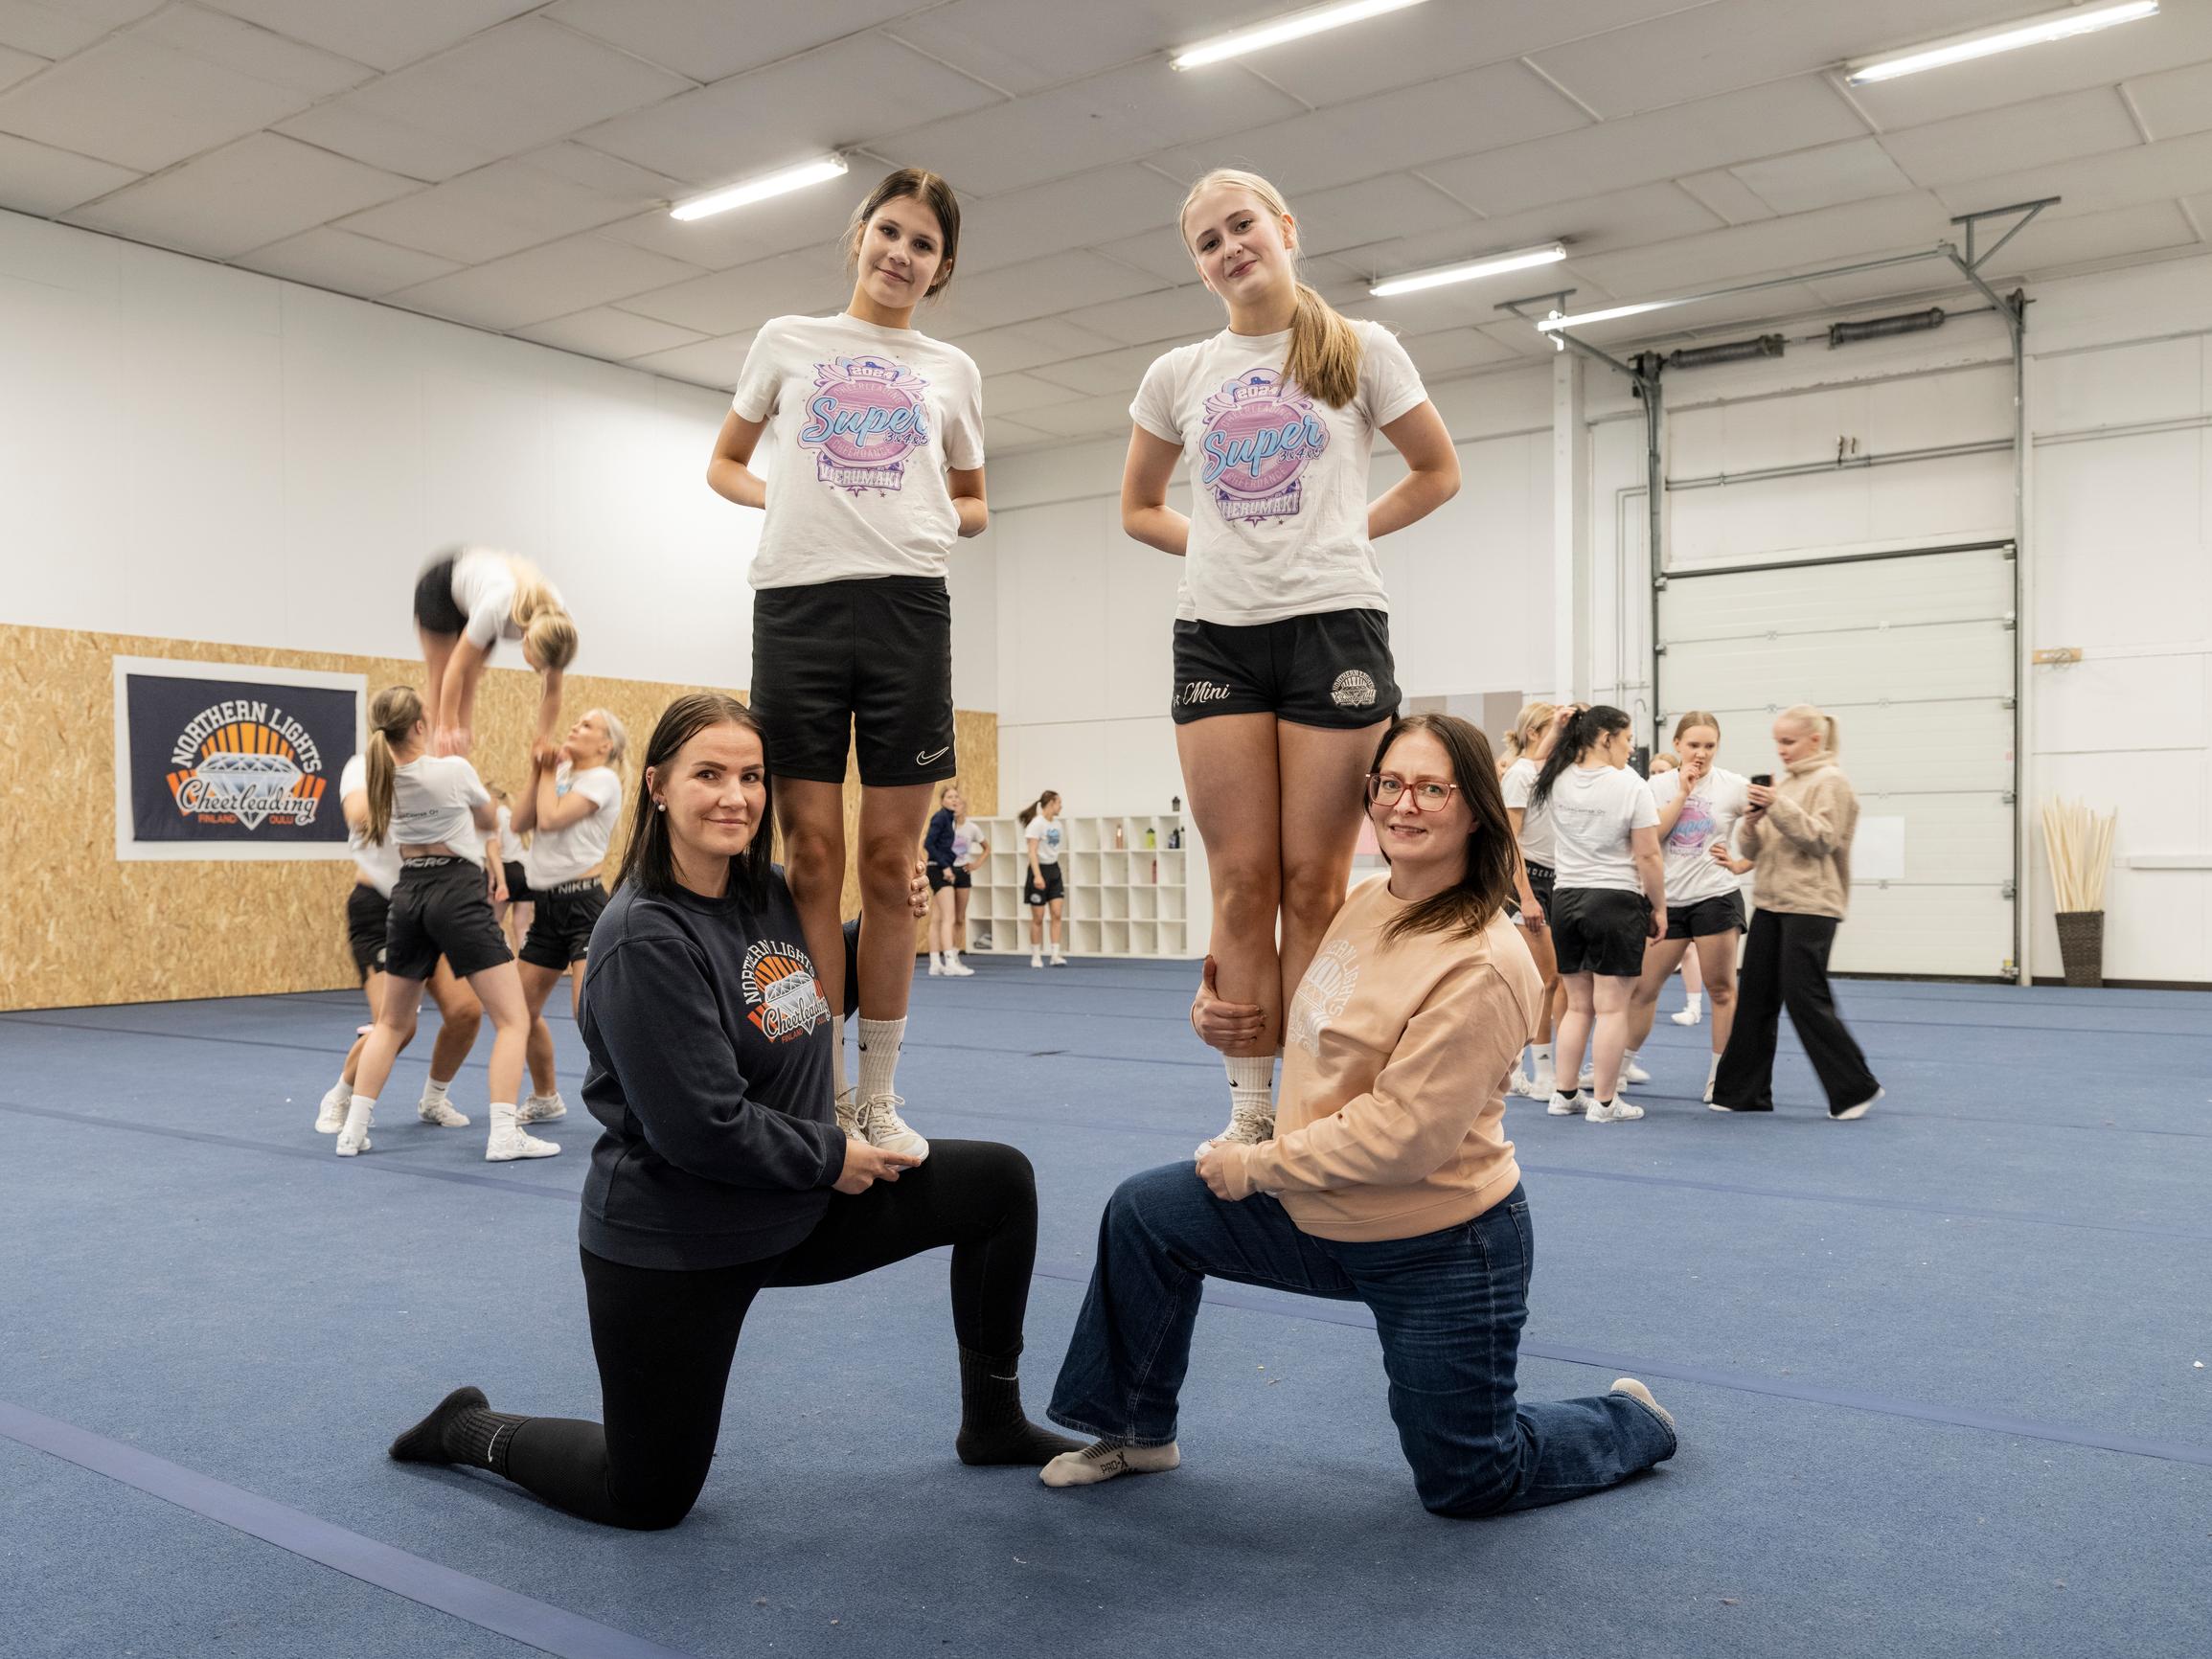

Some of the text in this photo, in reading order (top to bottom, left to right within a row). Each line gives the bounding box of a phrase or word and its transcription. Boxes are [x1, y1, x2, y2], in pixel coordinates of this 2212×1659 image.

[802, 397, 928, 448] Super
[1202, 415, 1324, 485] Super
[1183, 681, 1230, 705] Mini
[171, 700, 323, 774] NORTHERN LIGHTS
[176, 779, 316, 826] Cheerleading
[197, 812, 295, 825] FINLAND OULU
[770, 941, 815, 978] LIGHTS
